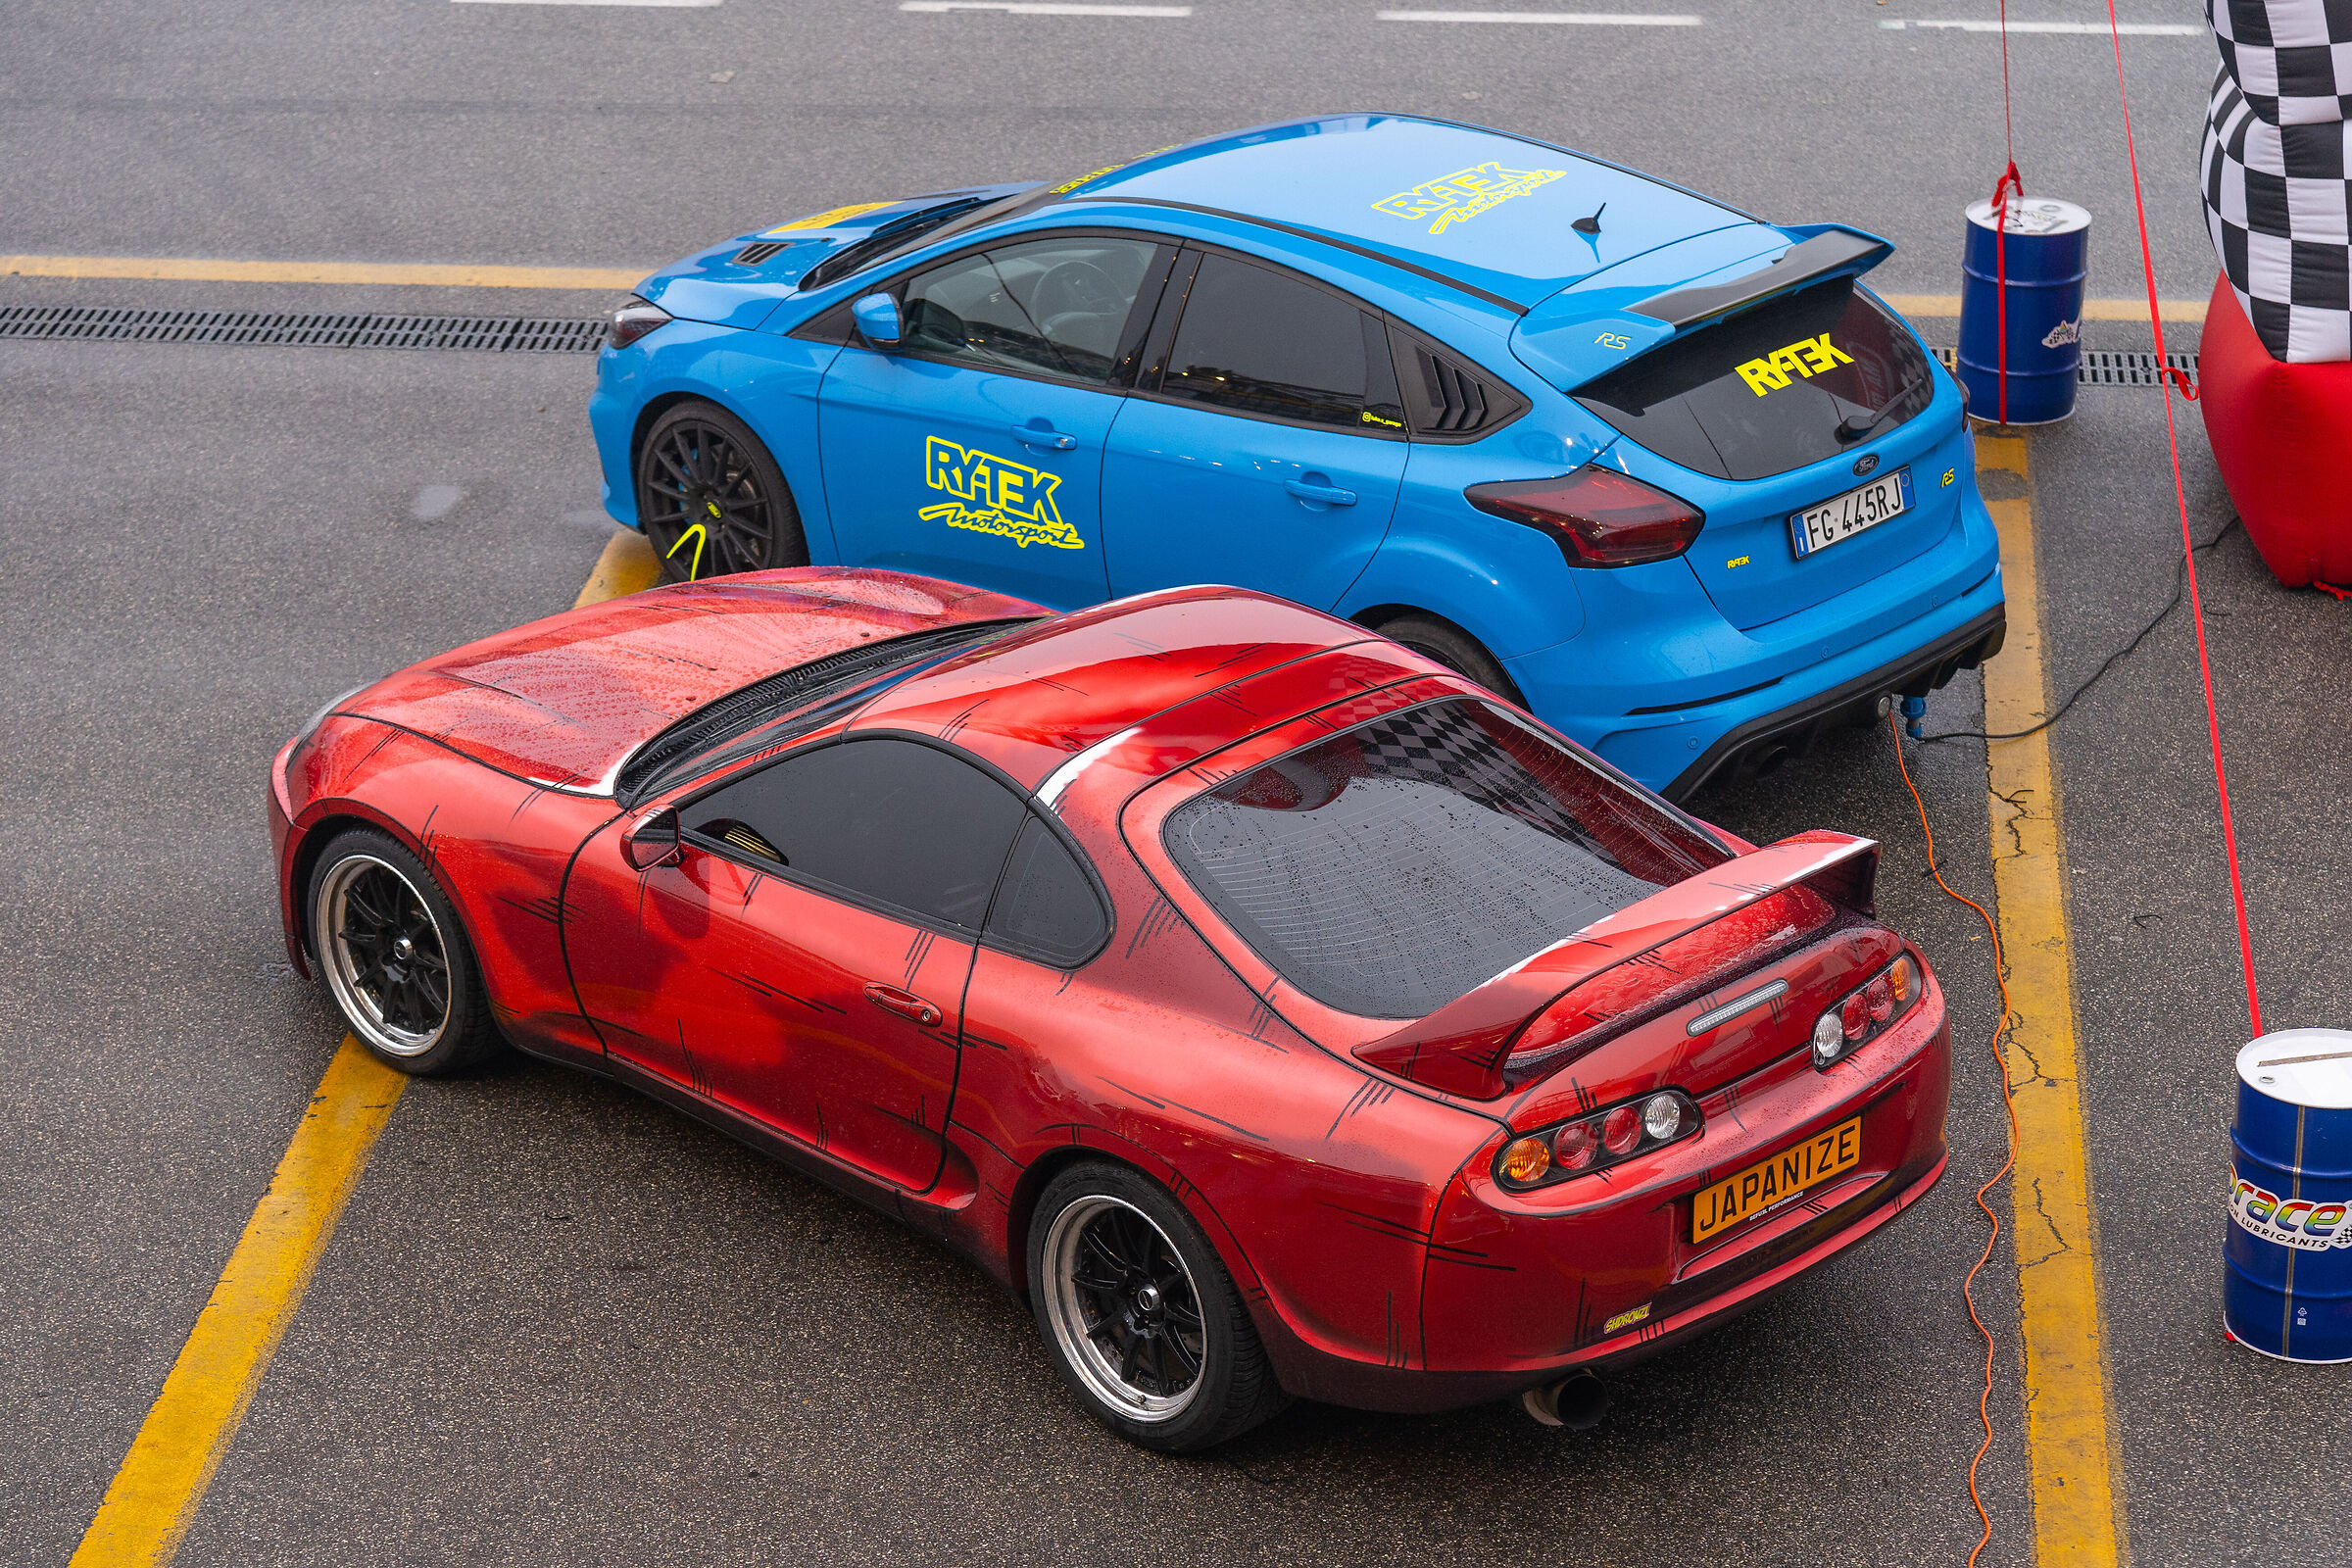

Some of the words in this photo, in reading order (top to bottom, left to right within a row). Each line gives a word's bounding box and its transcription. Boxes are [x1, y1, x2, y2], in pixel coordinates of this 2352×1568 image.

[1593, 331, 1632, 350] RS
[1940, 467, 1954, 488] RS
[1699, 1124, 1856, 1232] JAPANIZE
[1768, 1190, 1804, 1212] PERFORMANCE
[2240, 1216, 2329, 1248] LUBRICANTS
